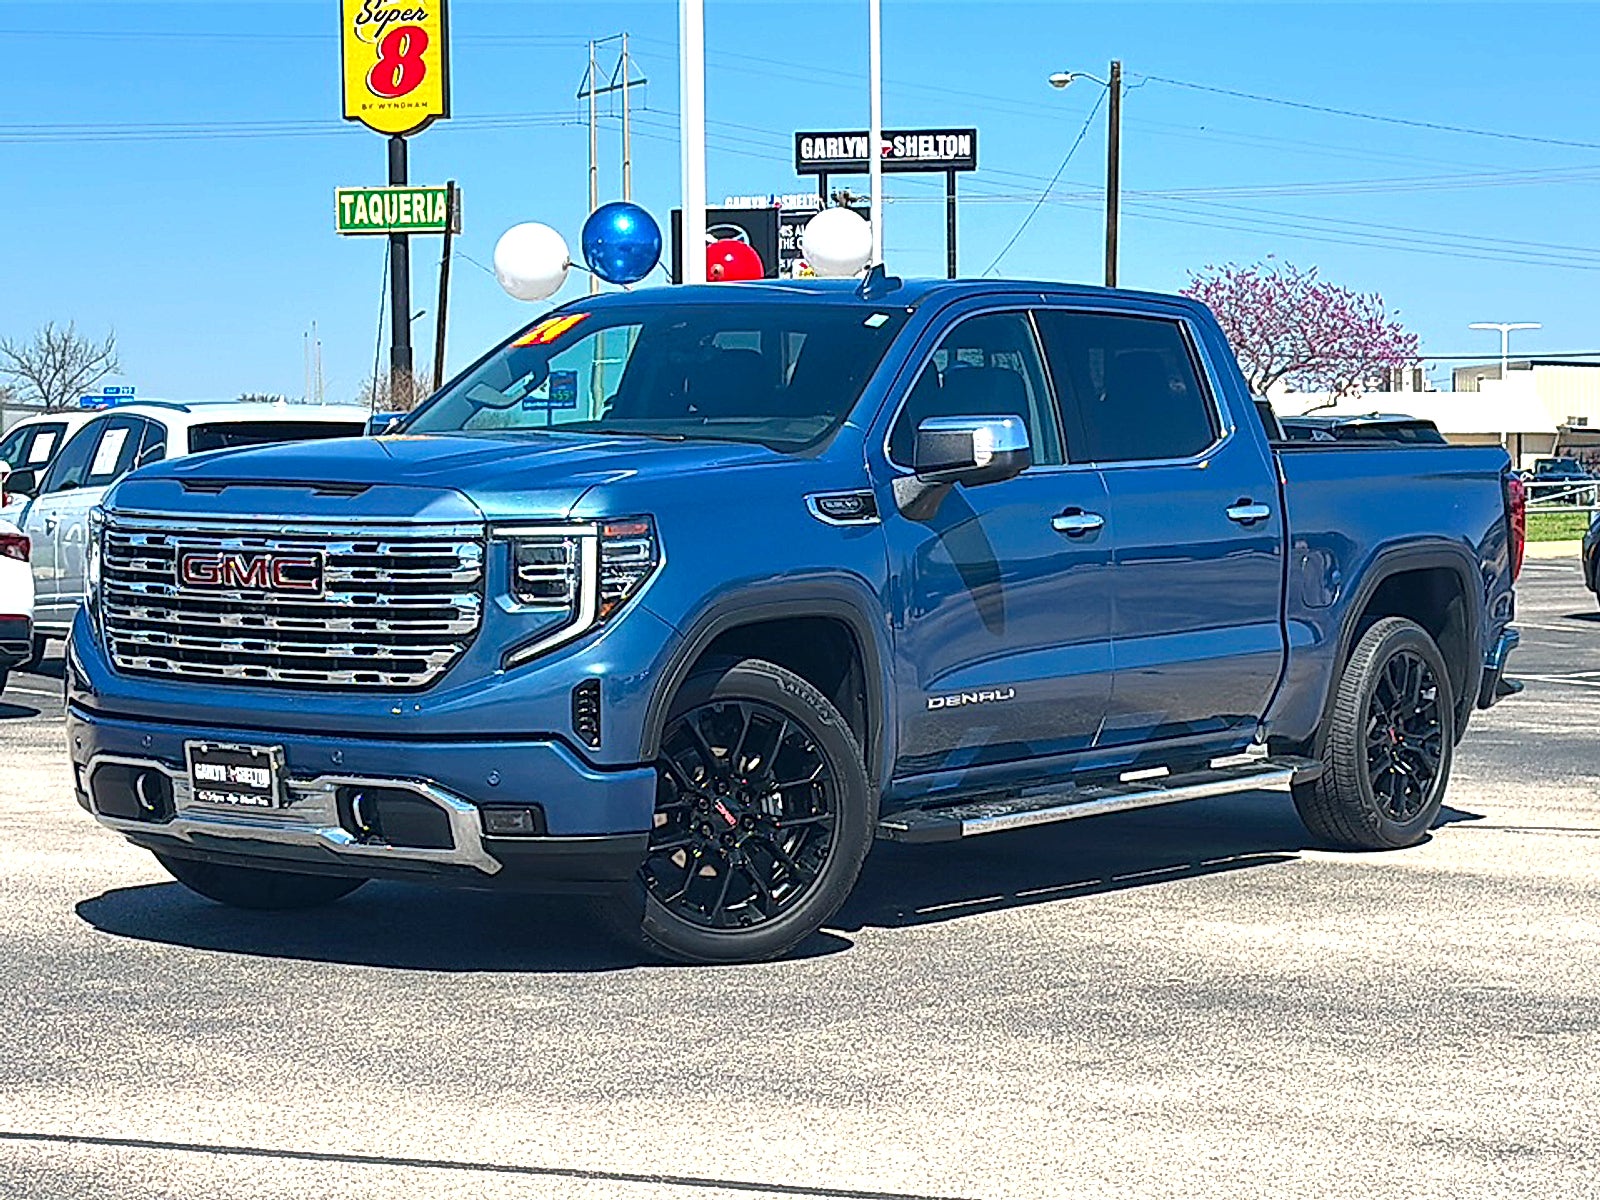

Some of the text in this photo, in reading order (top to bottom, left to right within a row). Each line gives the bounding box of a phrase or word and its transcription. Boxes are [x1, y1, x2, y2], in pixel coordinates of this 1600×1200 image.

[354, 0, 429, 38] Super
[365, 25, 429, 99] 8
[378, 102, 428, 110] WYNDHAM
[801, 134, 971, 160] GARLYN SHELTON
[340, 192, 447, 226] TAQUERIA
[182, 552, 318, 590] GMC
[927, 688, 1015, 710] DENALI
